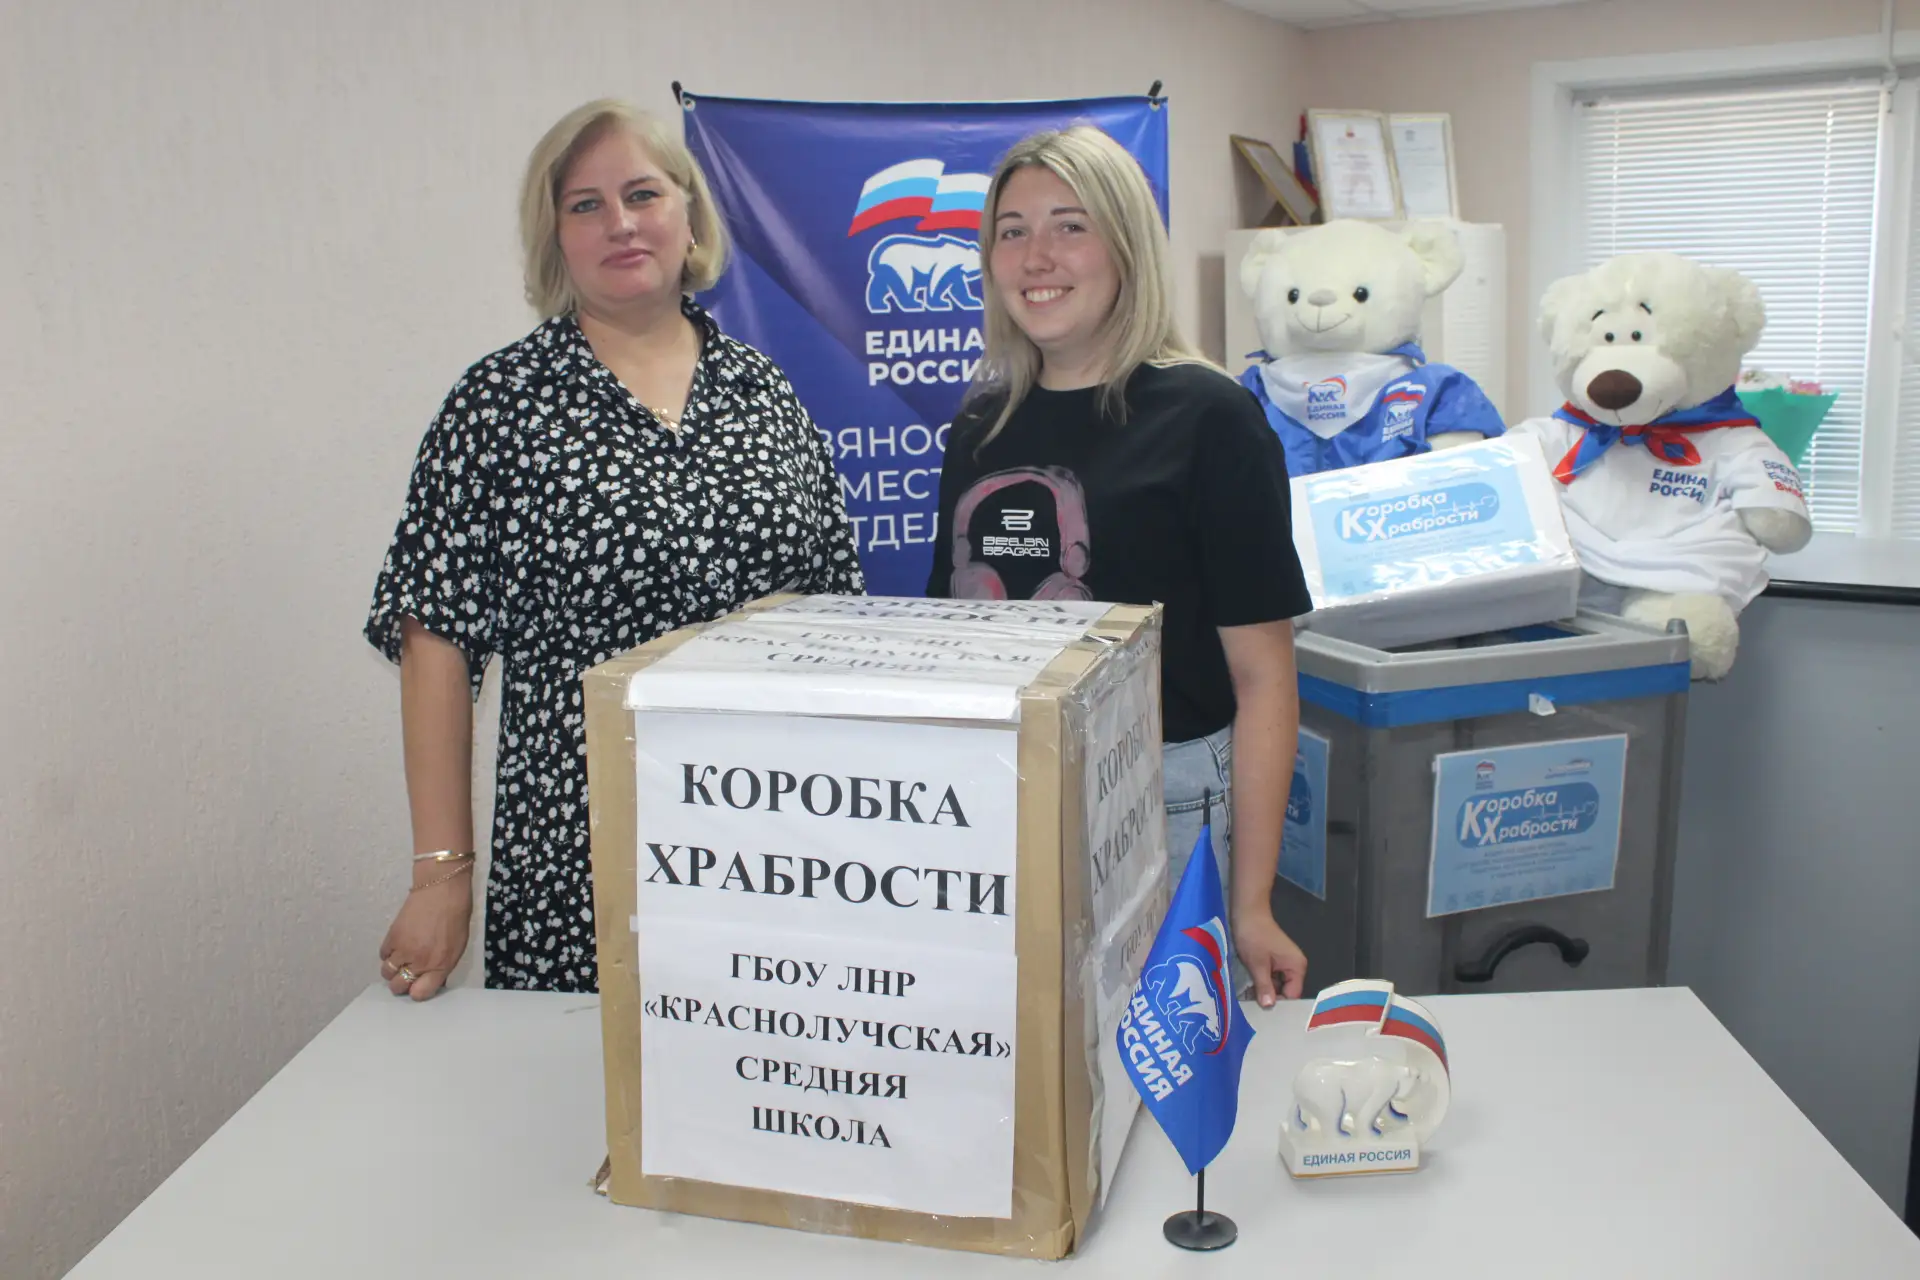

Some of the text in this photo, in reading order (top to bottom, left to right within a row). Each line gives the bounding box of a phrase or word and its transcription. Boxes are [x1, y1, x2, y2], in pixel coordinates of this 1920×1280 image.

[865, 327, 986, 358] ЕДИНА
[868, 358, 982, 386] РОССИ
[1649, 482, 1705, 503] РОССИ
[1652, 468, 1708, 489] ЕДИНА
[1341, 491, 1448, 540] Коробка
[1366, 509, 1480, 542] Храбрости
[682, 764, 971, 827] КОРОБКА
[1460, 788, 1558, 841] Коробка
[1478, 815, 1579, 846] Храбрости
[646, 843, 1008, 915] ХРАБРОСТИ
[732, 954, 915, 997] ГБОУ ЛНР
[645, 995, 1010, 1058] «КРАСНОЛУЧСКАЯ»
[1131, 977, 1194, 1087] ЕДИНАЯ
[1120, 1008, 1174, 1102] ОССИЯ
[736, 1056, 906, 1099] СРЕДНЯЯ
[753, 1107, 891, 1148] ШКОЛА
[1303, 1149, 1411, 1167] ЕДИНАЯ РОССИЯ
